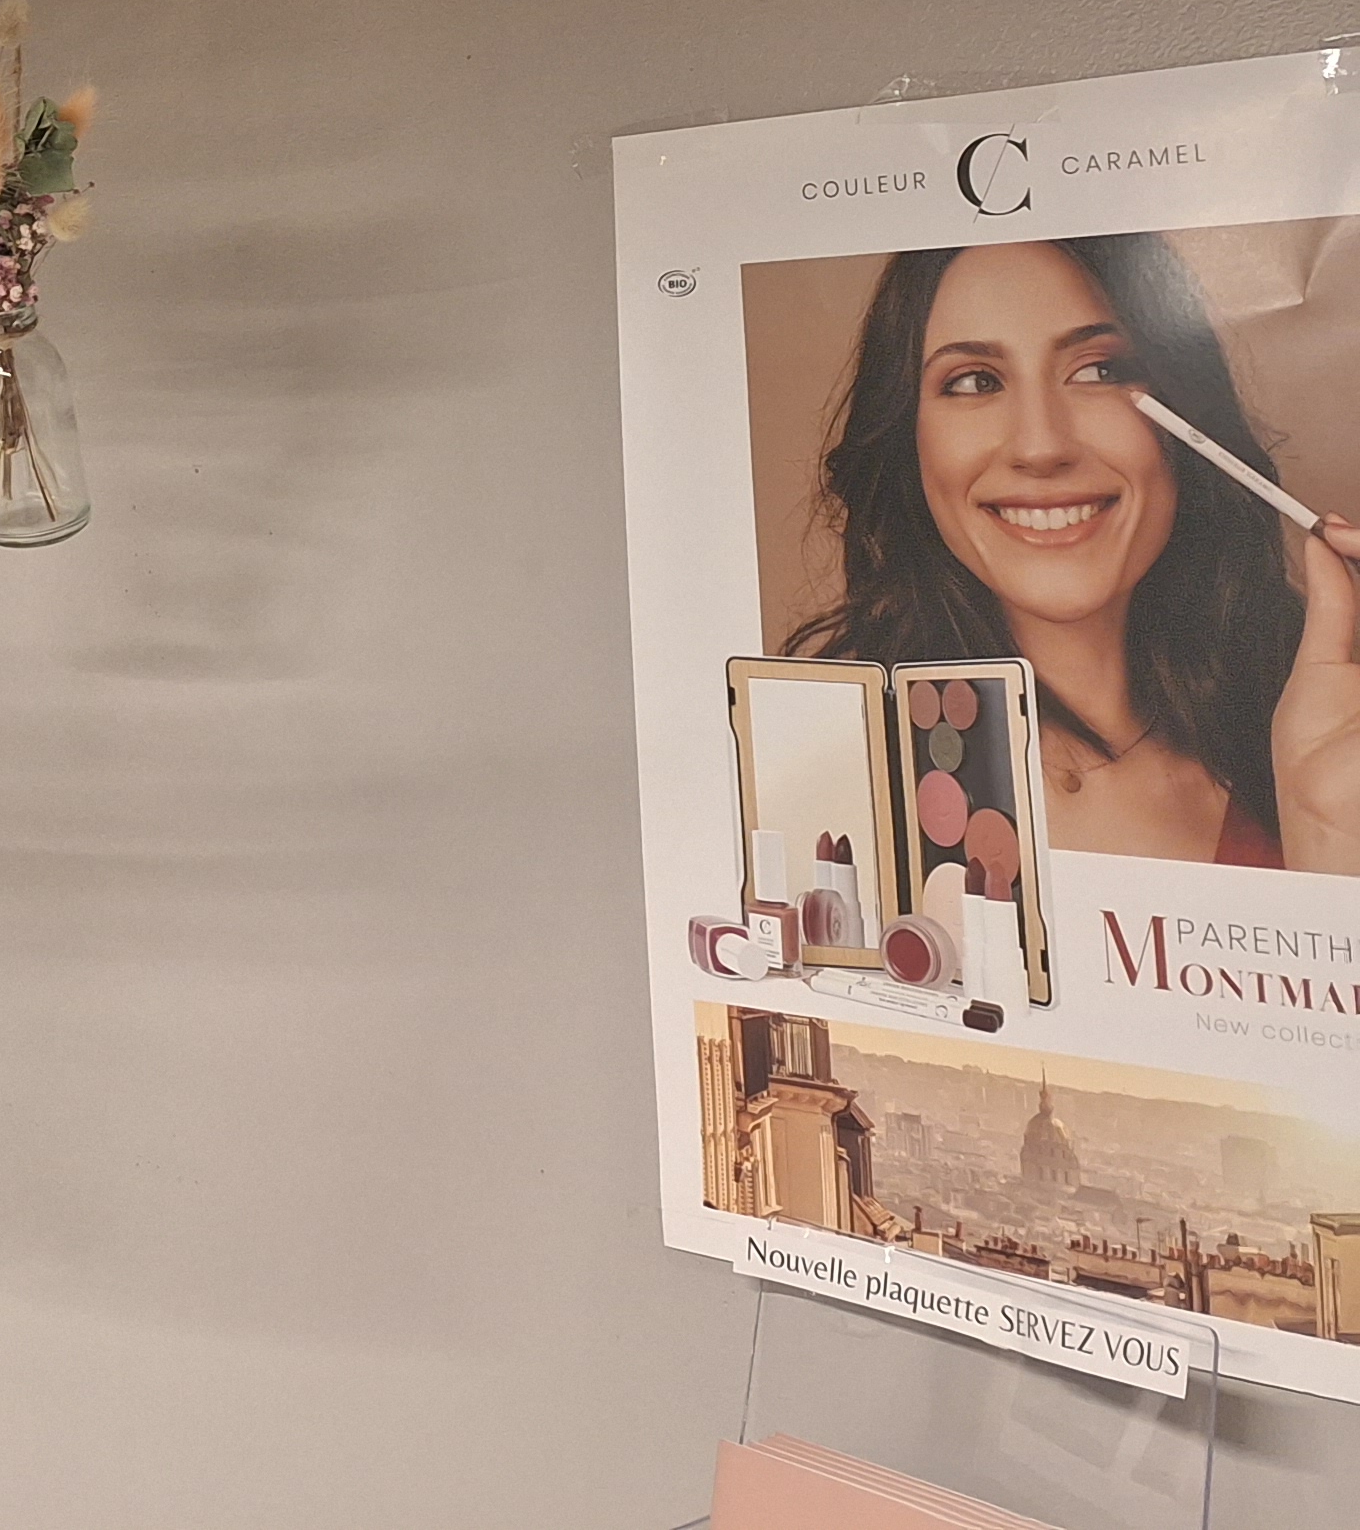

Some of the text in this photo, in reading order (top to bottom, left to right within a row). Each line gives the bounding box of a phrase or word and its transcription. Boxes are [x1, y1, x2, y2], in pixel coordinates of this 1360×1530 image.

[801, 131, 1207, 217] COULEUR C CARAMEL
[668, 279, 688, 289] BIO
[1176, 917, 1360, 964] PARENTH
[1195, 1011, 1360, 1052] New collect
[747, 1236, 1181, 1377] Nouvelle plaquette SERVEZ VOUS
